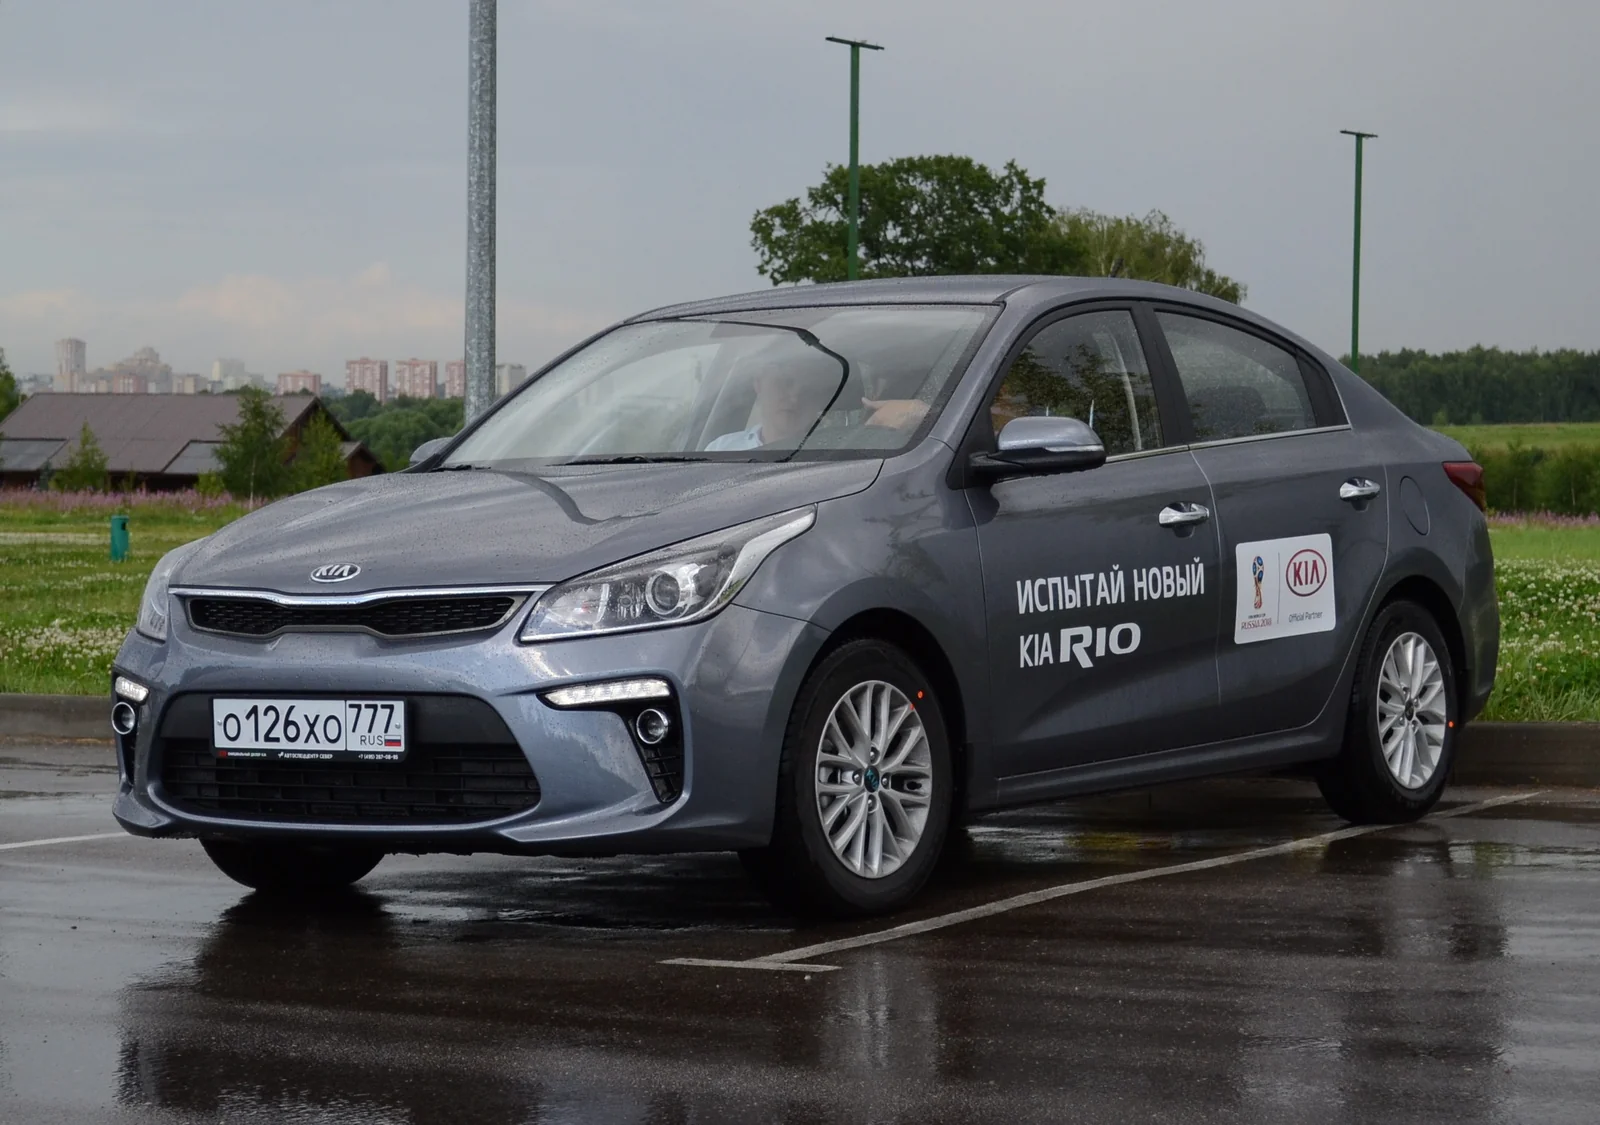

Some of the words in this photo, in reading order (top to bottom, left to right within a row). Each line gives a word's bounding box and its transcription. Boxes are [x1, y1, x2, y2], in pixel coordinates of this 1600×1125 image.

[315, 564, 351, 577] KIA
[1293, 559, 1320, 587] KIA
[1016, 564, 1125, 614] ИСПЫТАЙ
[1133, 556, 1205, 601] НОВЫЙ
[1305, 611, 1323, 620] Partner
[1020, 632, 1054, 668] KIA
[1059, 622, 1142, 669] RIO
[348, 703, 395, 734] 777
[360, 735, 383, 746] RUS
